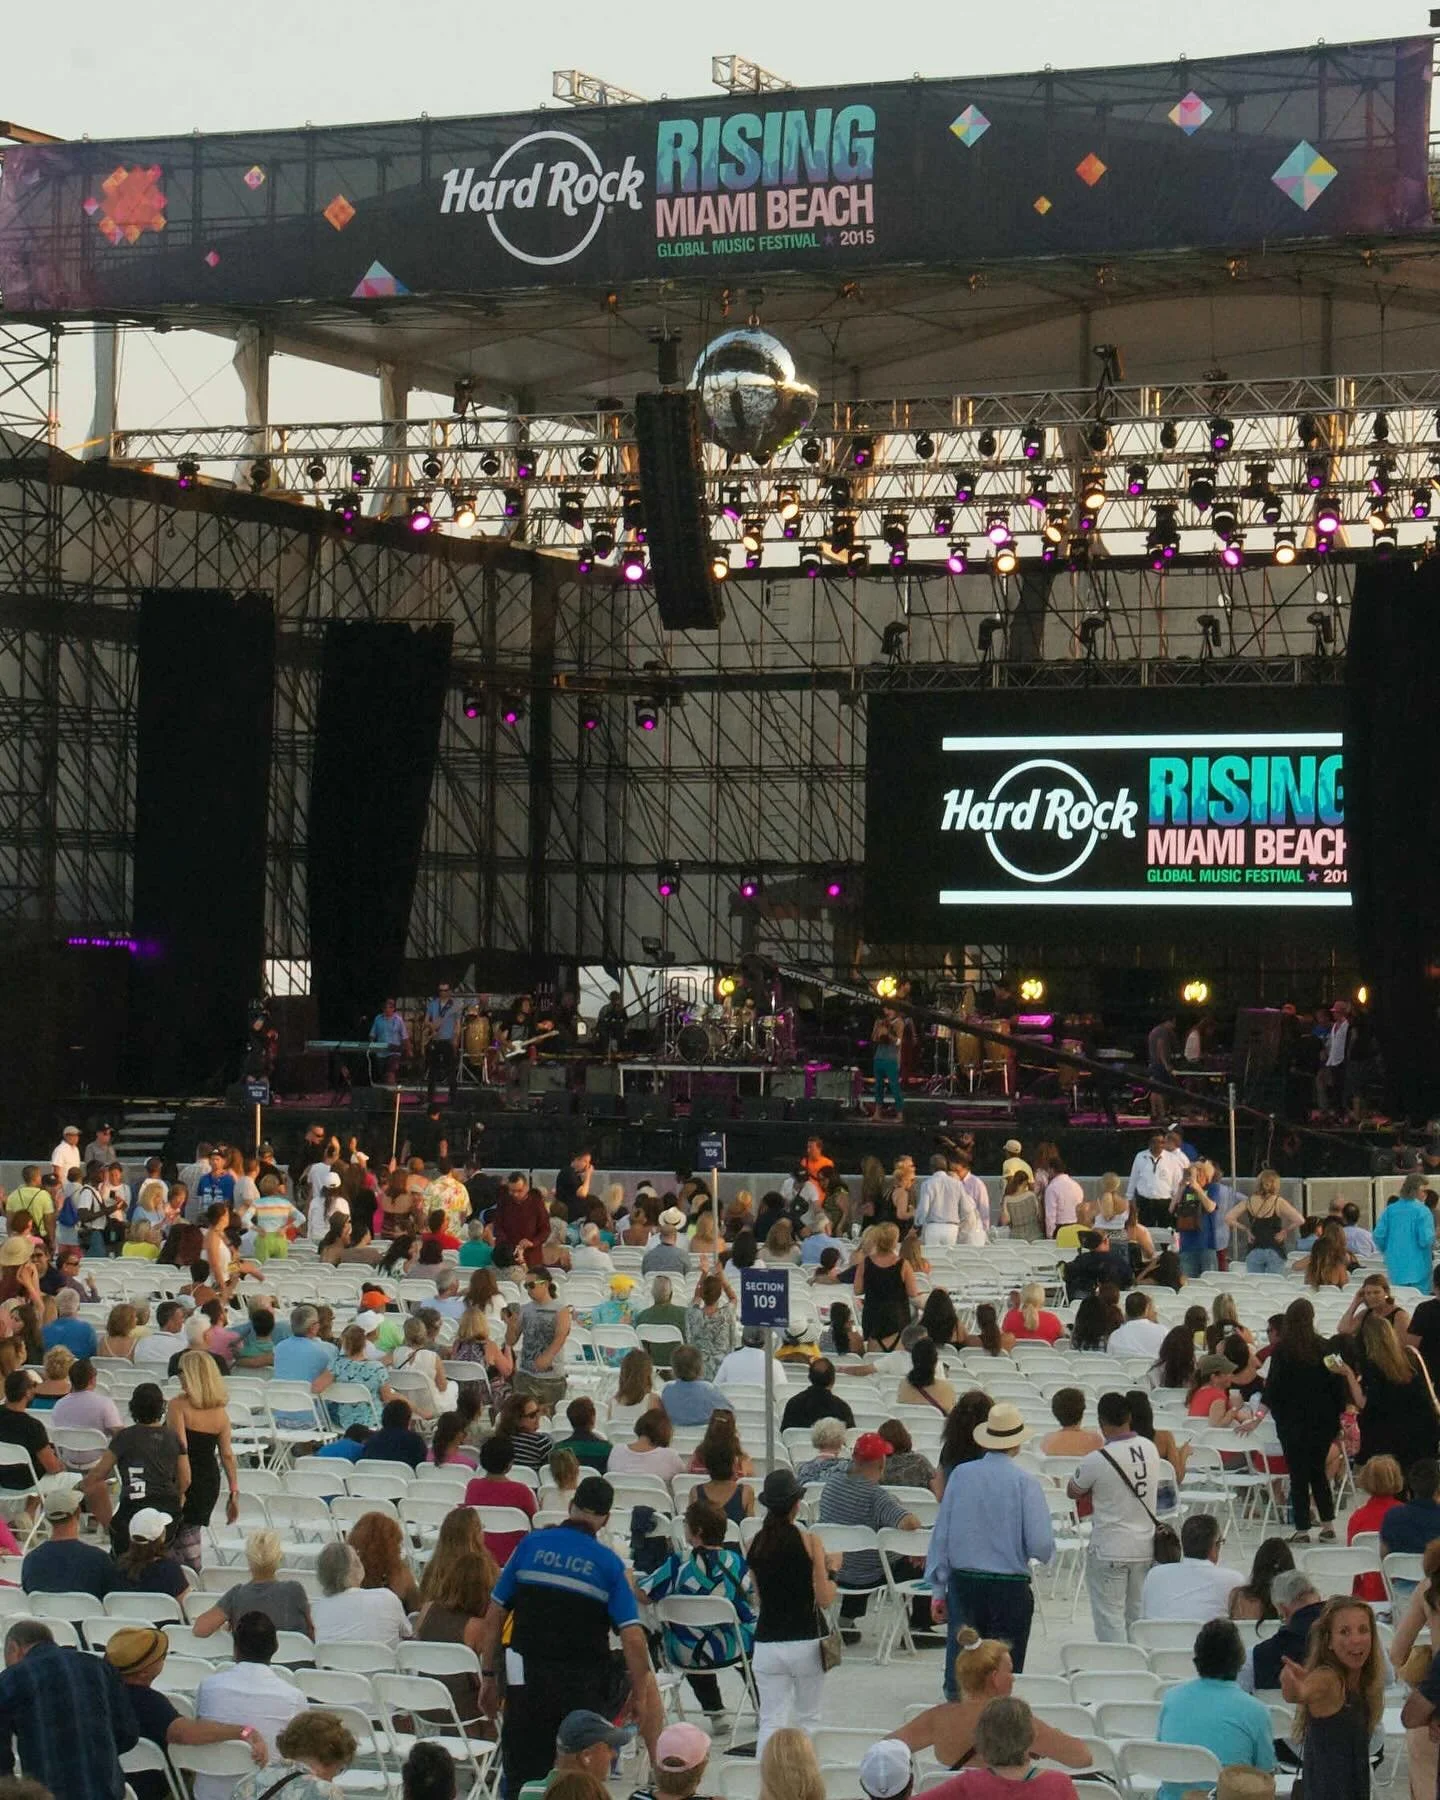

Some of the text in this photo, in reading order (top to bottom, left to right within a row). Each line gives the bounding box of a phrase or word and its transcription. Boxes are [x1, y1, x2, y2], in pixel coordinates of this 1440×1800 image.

[656, 104, 877, 196] RISING
[440, 156, 646, 217] Hard Rock
[656, 184, 875, 238] MIAMI BEACH
[657, 229, 876, 258] GLOBAL MUSIC FESTIVAL 2015
[940, 787, 1139, 840] Hard Rock
[1147, 828, 1246, 865] MIAMI
[1147, 868, 1196, 883] GLOBAL
[1199, 868, 1242, 883] MUSIC
[1245, 868, 1305, 883] FESTIVAL
[745, 1281, 785, 1292] SECTION
[753, 1294, 777, 1309] 109
[534, 1550, 596, 1576] POLICE
